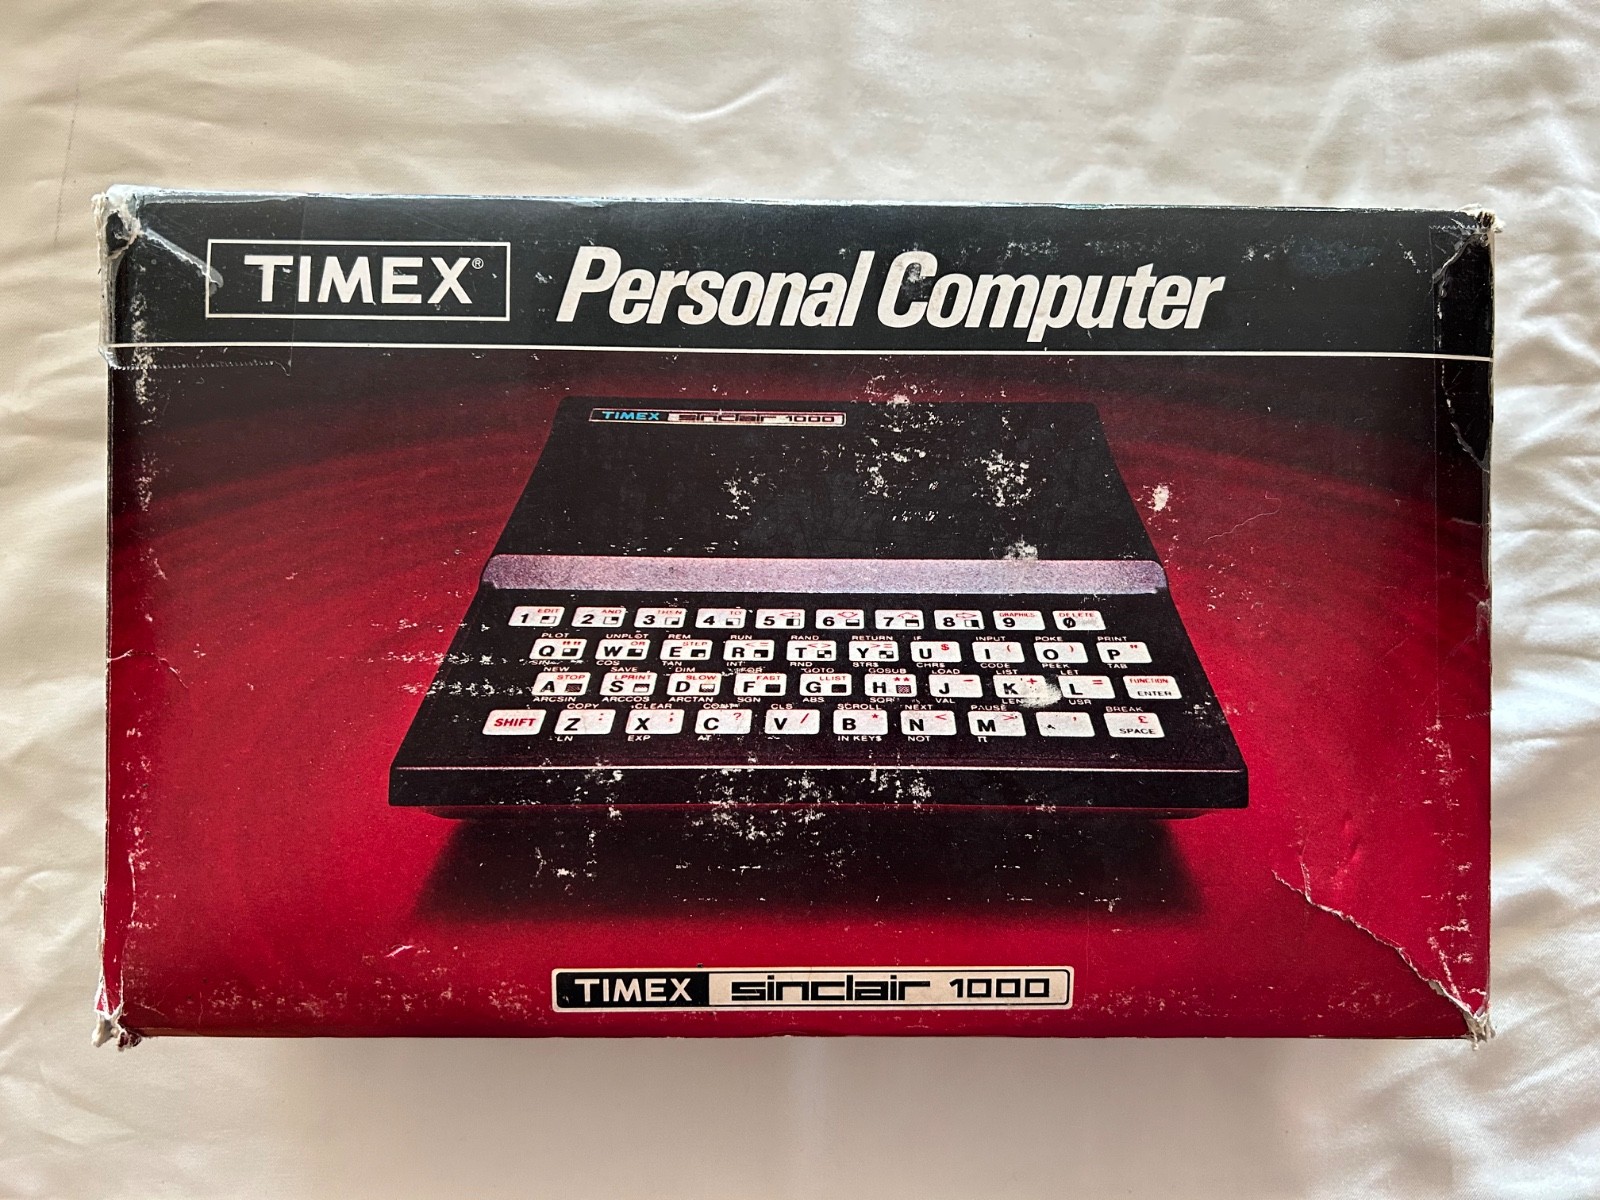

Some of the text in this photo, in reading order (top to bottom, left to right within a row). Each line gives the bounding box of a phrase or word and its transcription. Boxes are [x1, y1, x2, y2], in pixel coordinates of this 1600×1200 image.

[555, 245, 1226, 343] Personal Computer
[602, 410, 660, 420] TIMEX
[786, 414, 835, 422] 1000
[520, 613, 530, 624] 1
[581, 614, 594, 624] 2
[643, 614, 656, 625] 3
[703, 616, 715, 626] 4
[763, 616, 775, 626] 5
[823, 616, 835, 626] 6
[883, 617, 894, 627] 7
[943, 617, 956, 628] 8
[1002, 618, 1016, 628] 9
[538, 646, 555, 657] Q
[604, 646, 623, 657] W
[670, 646, 683, 657] E
[732, 647, 744, 658] R
[795, 648, 808, 658] T
[856, 648, 870, 658] Y
[919, 648, 932, 659] U
[984, 649, 991, 659] I
[1043, 649, 1058, 660] O
[1107, 649, 1120, 660] P
[540, 681, 555, 693] A
[609, 681, 624, 692] S
[675, 681, 691, 692] D
[743, 681, 755, 693] F
[805, 682, 822, 693] G
[872, 682, 886, 693] H
[939, 683, 950, 694] J
[1070, 684, 1083, 695] L
[494, 718, 536, 727] SHIFT
[564, 718, 581, 731] Z
[634, 718, 650, 730] X
[703, 718, 719, 730] C
[774, 718, 788, 730] V
[842, 718, 856, 731] B
[909, 719, 924, 731] N
[976, 720, 996, 732] M
[574, 974, 1051, 1002] TIMEX sinclair 1000
